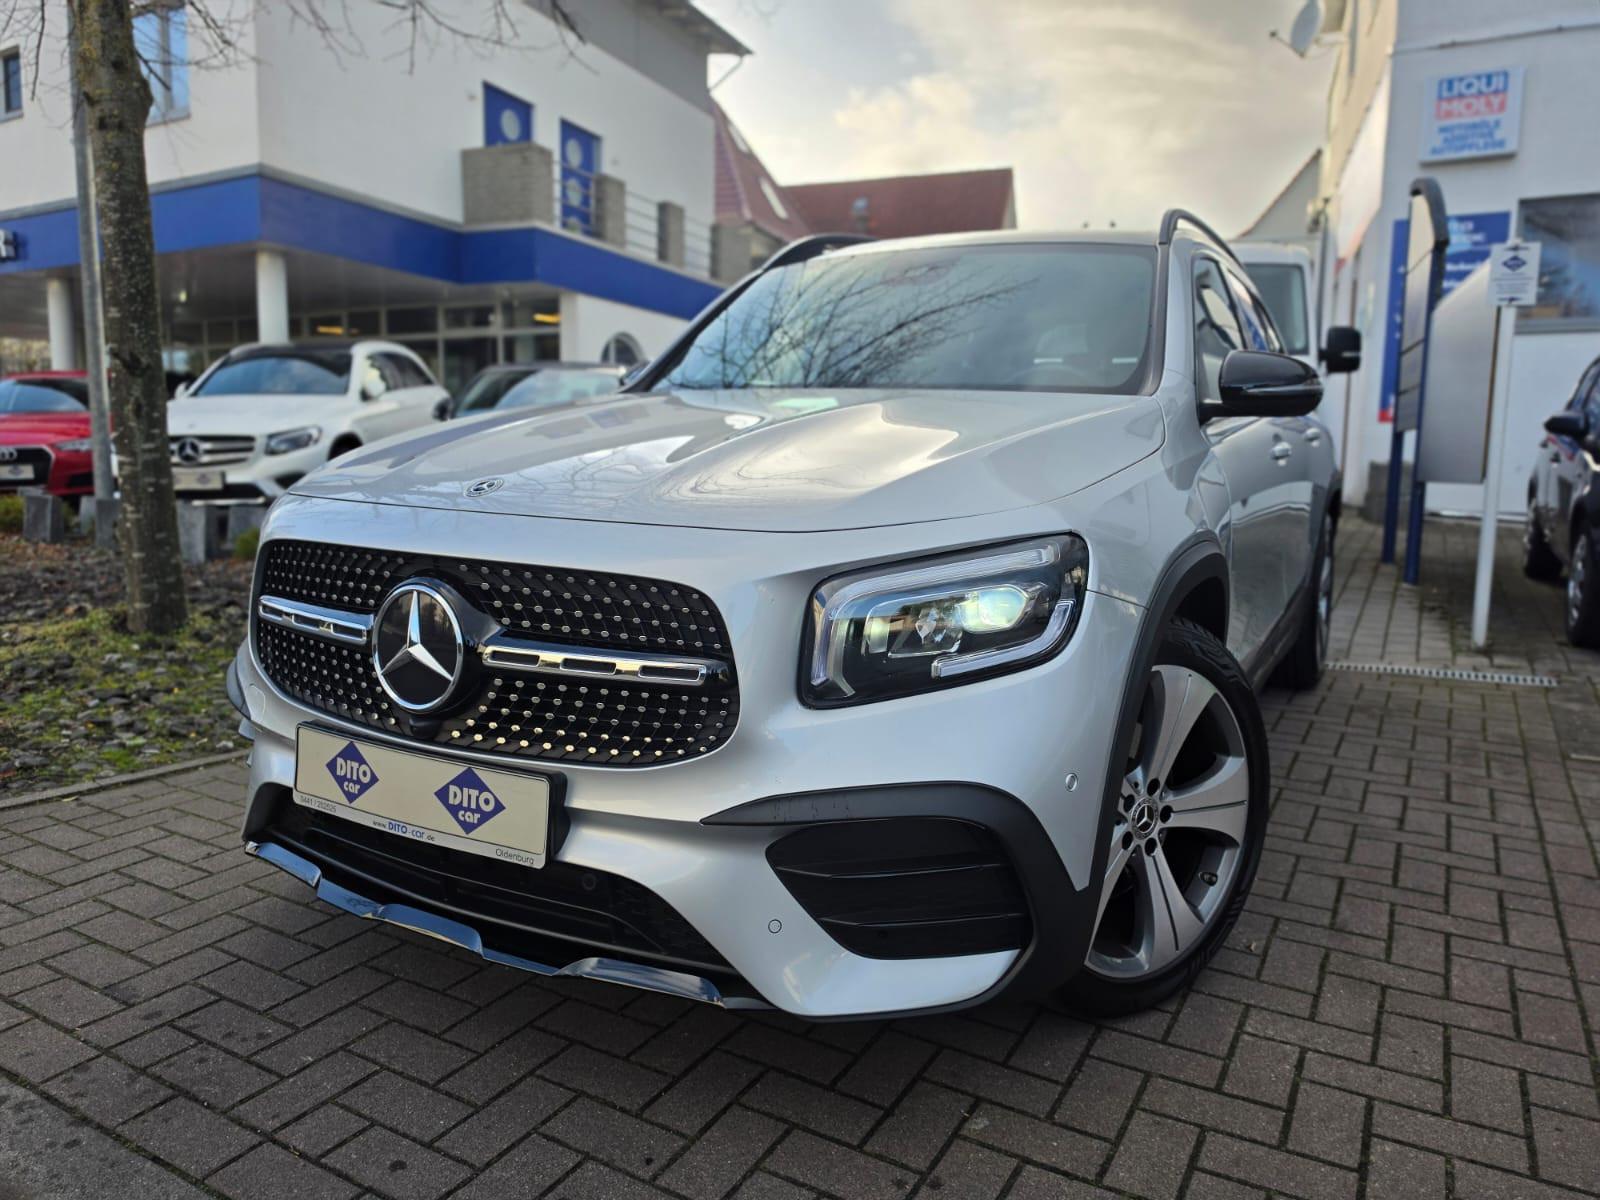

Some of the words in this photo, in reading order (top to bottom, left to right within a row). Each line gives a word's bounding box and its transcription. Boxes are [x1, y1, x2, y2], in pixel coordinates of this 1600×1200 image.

[1439, 72, 1507, 99] LIQUI
[1436, 93, 1505, 120] MOLY
[336, 757, 371, 781] DITO
[343, 780, 361, 795] car
[448, 784, 496, 813] DITO
[458, 809, 481, 825] car
[495, 848, 535, 865] Oldenburg
